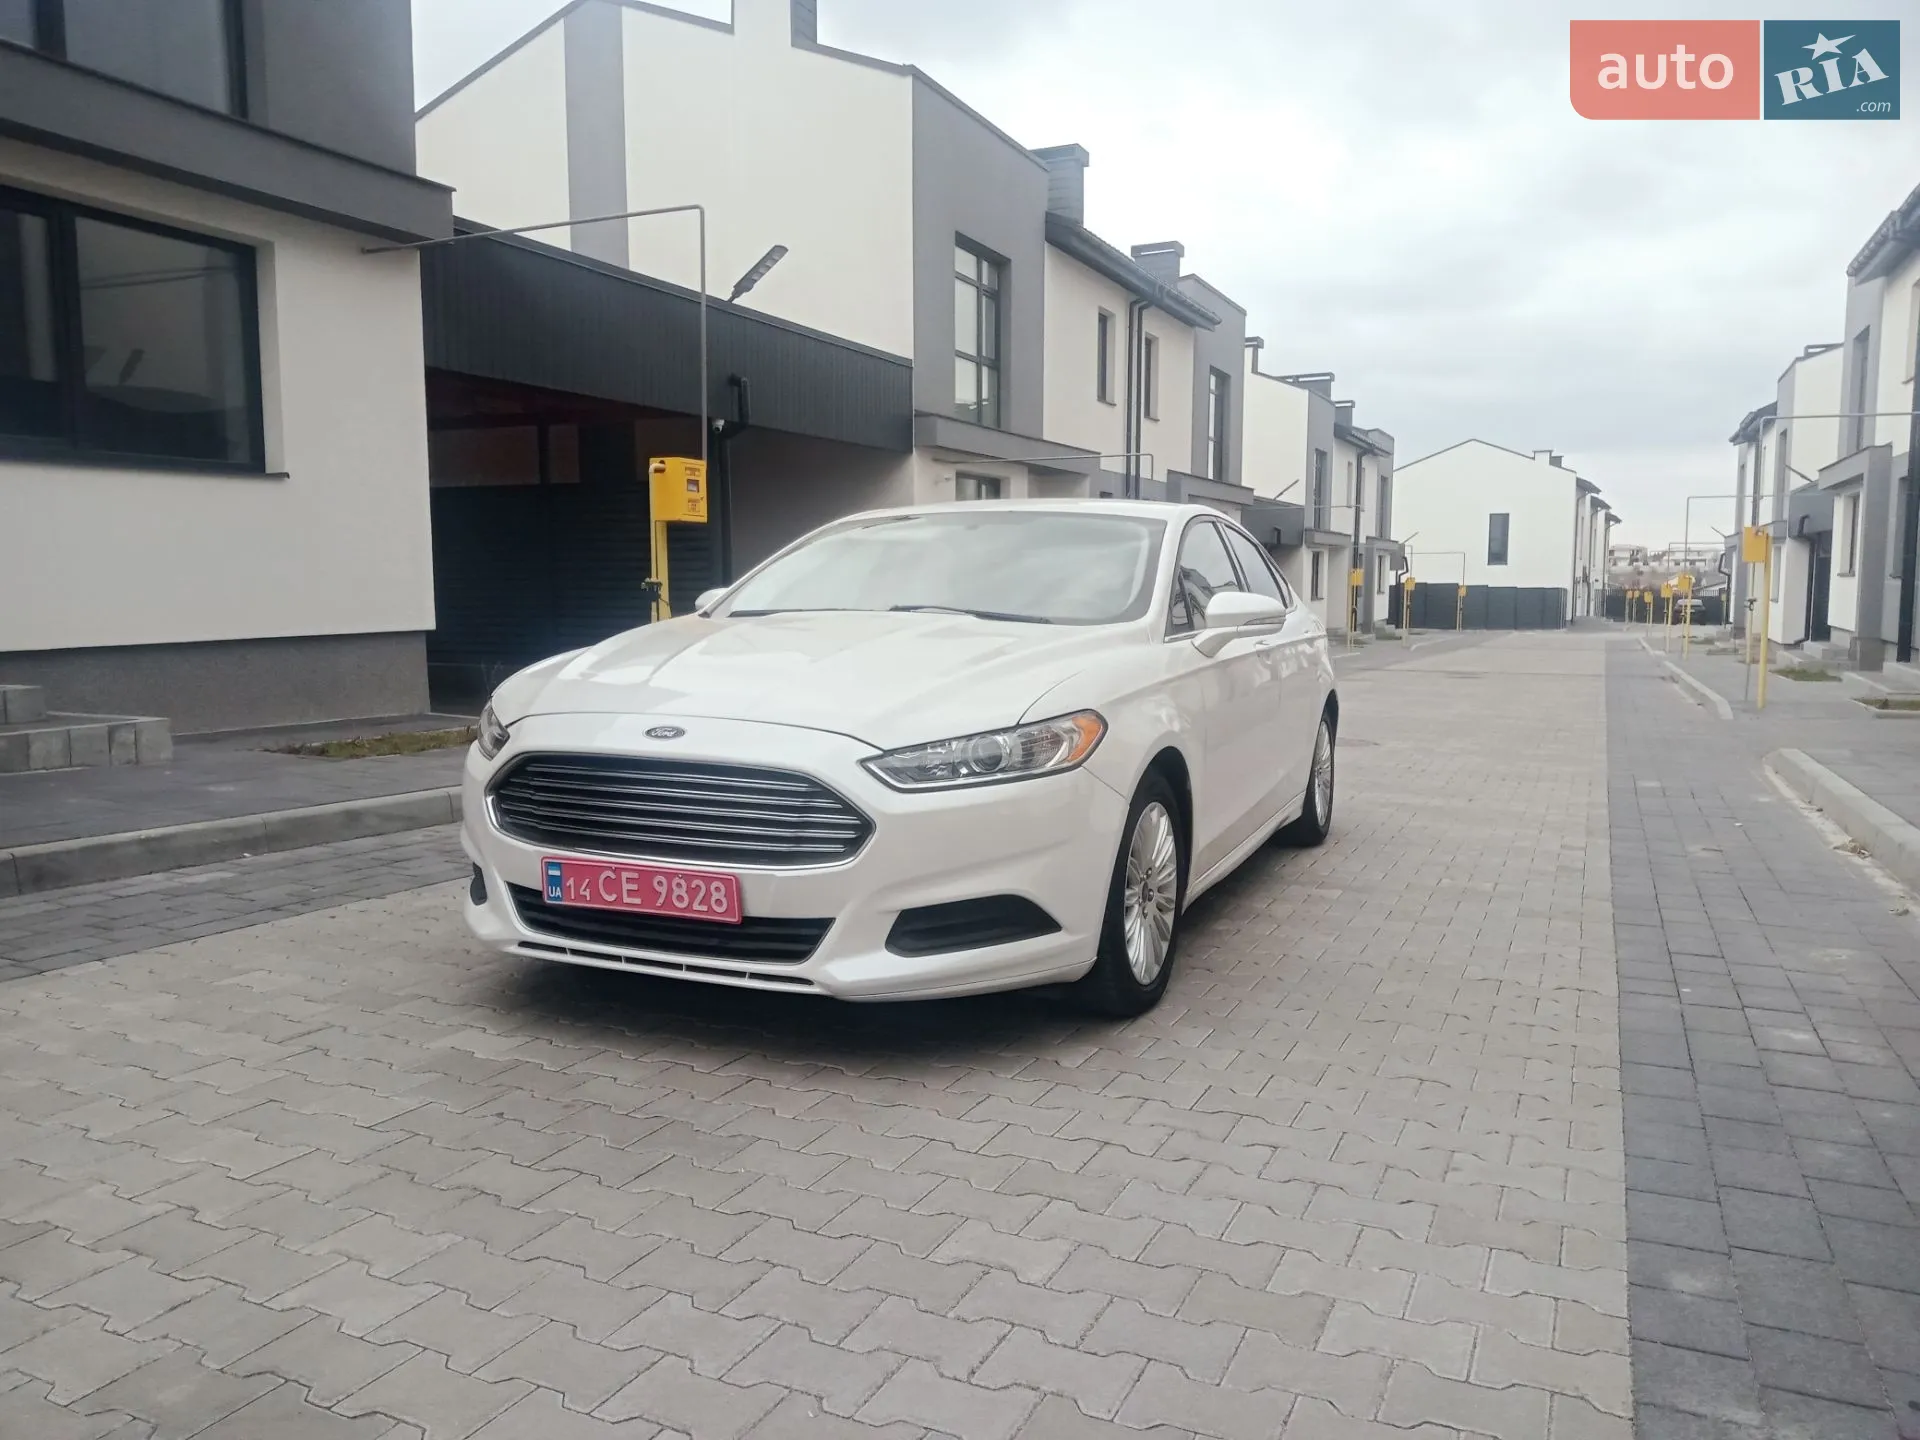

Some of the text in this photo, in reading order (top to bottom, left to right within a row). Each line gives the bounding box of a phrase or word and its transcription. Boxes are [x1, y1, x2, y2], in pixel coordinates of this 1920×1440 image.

[651, 727, 677, 737] Ford
[548, 885, 562, 898] UA
[566, 870, 728, 914] 14 CE 9828
